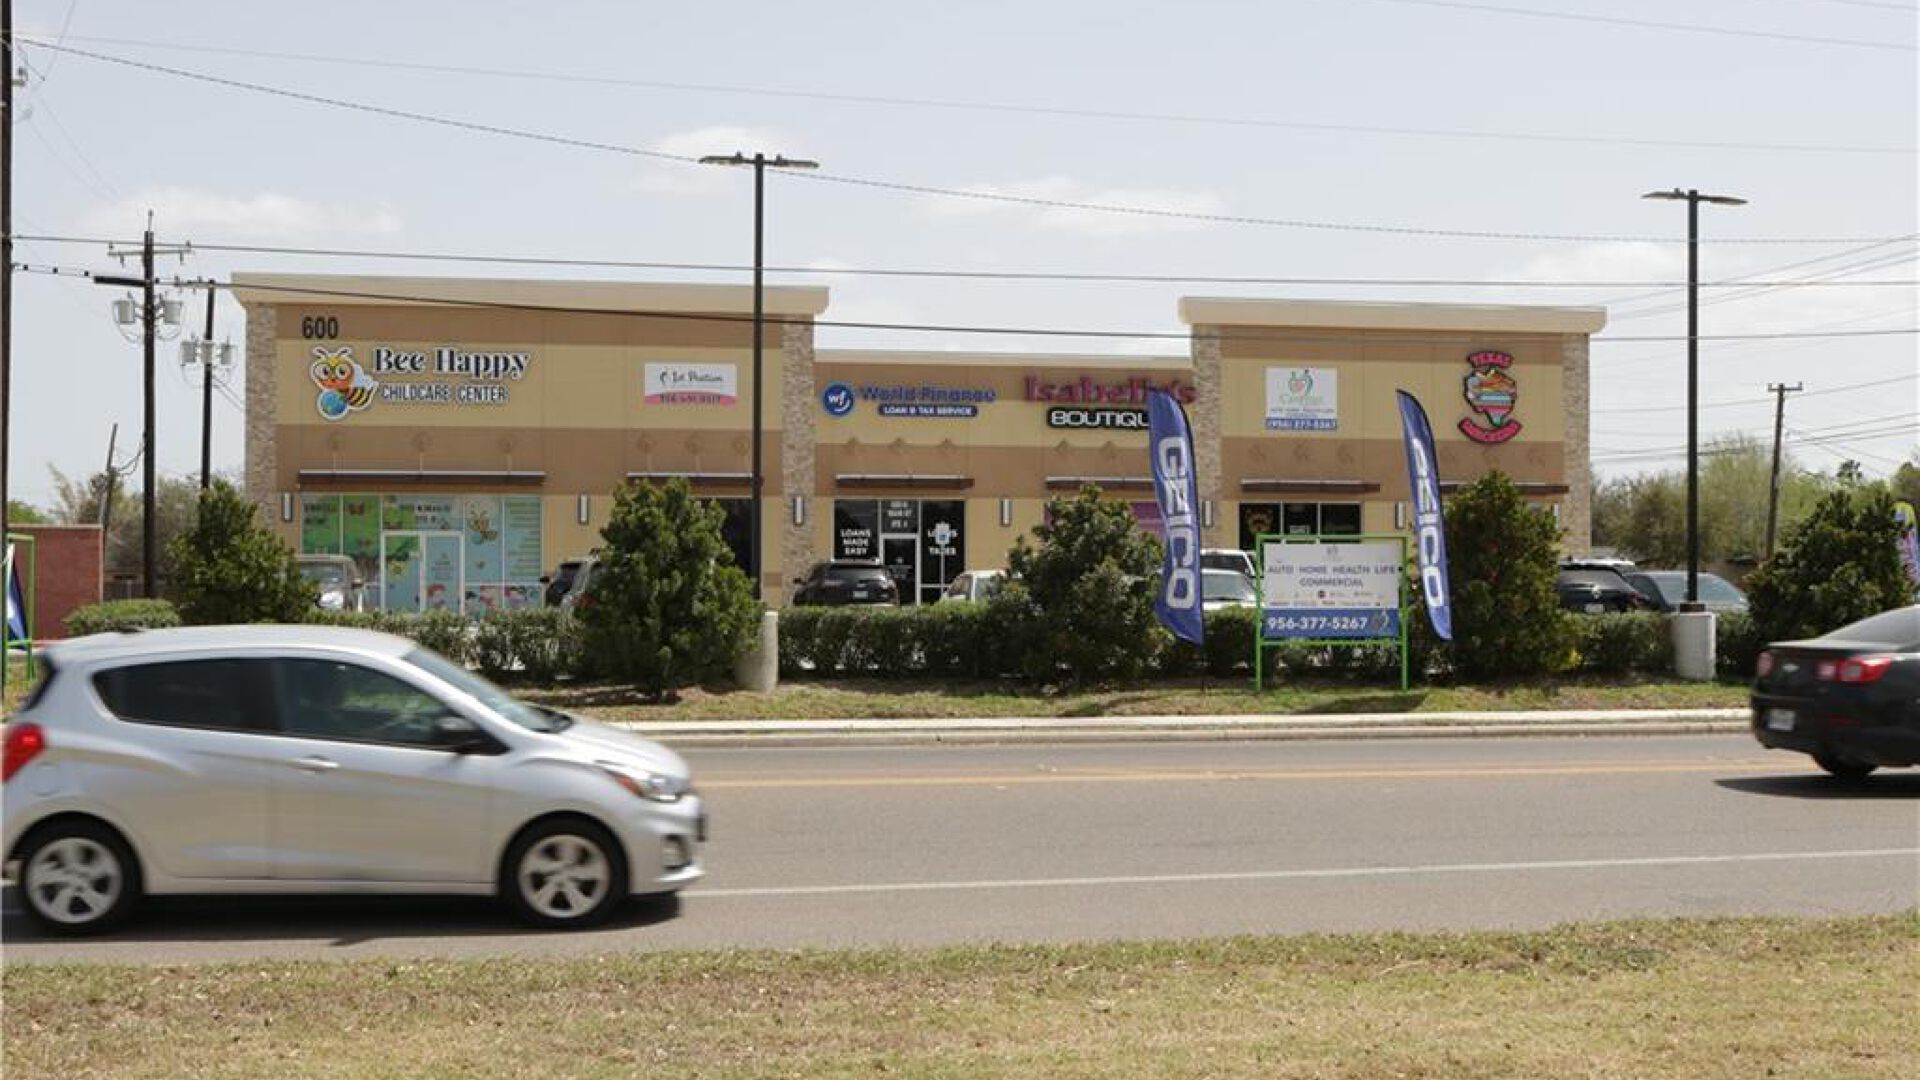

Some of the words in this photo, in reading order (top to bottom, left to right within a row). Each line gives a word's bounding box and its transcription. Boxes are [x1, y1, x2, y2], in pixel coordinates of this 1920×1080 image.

[302, 317, 339, 338] 600
[374, 348, 425, 372] Bee
[435, 348, 529, 379] Happy
[382, 384, 450, 401] CHILDCARE
[457, 385, 507, 402] CENTER
[864, 386, 916, 402] World
[922, 387, 996, 402] Finance
[884, 406, 907, 415] LOAN
[918, 406, 934, 415] TAX
[937, 406, 973, 415] SERVICE
[1051, 410, 1150, 427] BOUTIQU
[1158, 436, 1196, 609] GEICO
[841, 529, 871, 538] LOANS
[843, 538, 869, 547] MADE
[845, 547, 867, 556] EASY
[929, 547, 956, 556] TAES
[1268, 565, 1295, 574] AUTO
[1299, 565, 1327, 574] HOME
[1333, 565, 1371, 574] HEALTH
[1375, 565, 1396, 574] LIFE
[1299, 577, 1364, 588] COMMERCIAL
[1267, 616, 1368, 630] 956-377-5267
